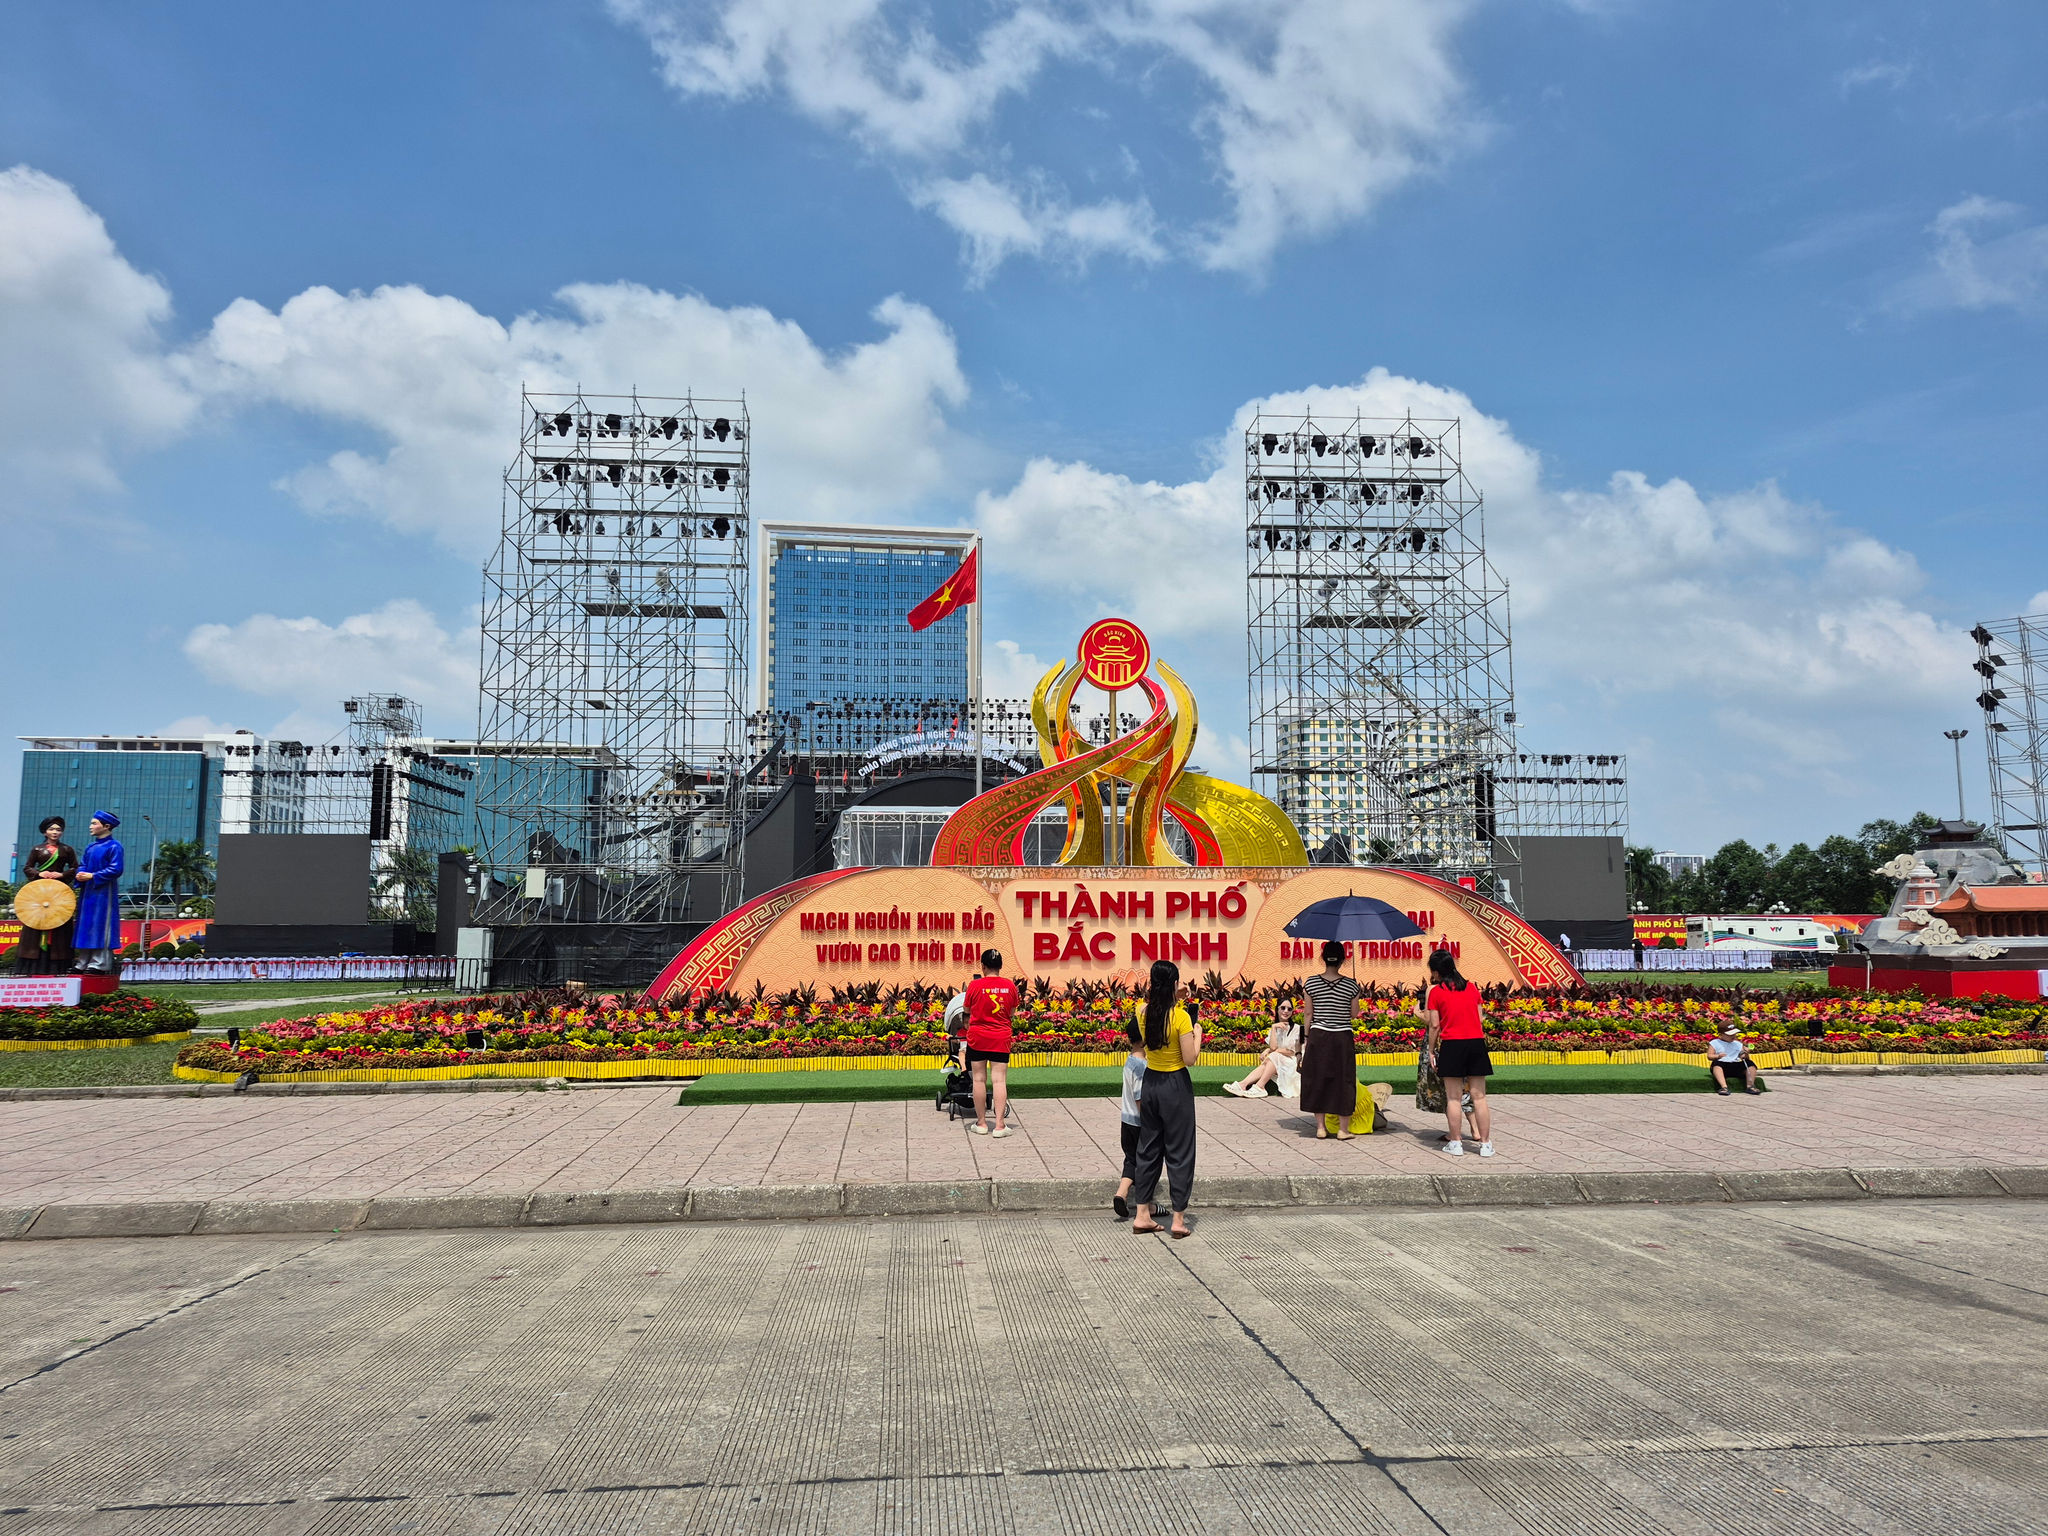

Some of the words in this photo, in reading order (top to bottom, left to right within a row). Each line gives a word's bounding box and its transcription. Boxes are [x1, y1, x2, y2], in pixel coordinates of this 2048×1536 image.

[858, 761, 879, 777] CHÀO
[902, 743, 928, 757] THÀNH
[1008, 758, 1028, 775] NINH
[1016, 883, 1154, 919] THÀNH
[1166, 881, 1248, 919] PHỐ
[800, 912, 849, 933] MẠCH
[855, 904, 911, 930] NGUỒN
[917, 912, 955, 930] KINH
[962, 905, 995, 930] BẮC
[1653, 918, 1672, 928] PHỐ
[1673, 918, 1687, 928] BẮ
[816, 941, 862, 962] VƯƠN
[868, 943, 901, 962] CAO
[907, 939, 945, 962] THỜI
[952, 942, 981, 964] ĐẠI
[1033, 921, 1116, 961] BẮC
[1131, 932, 1228, 961] NINH
